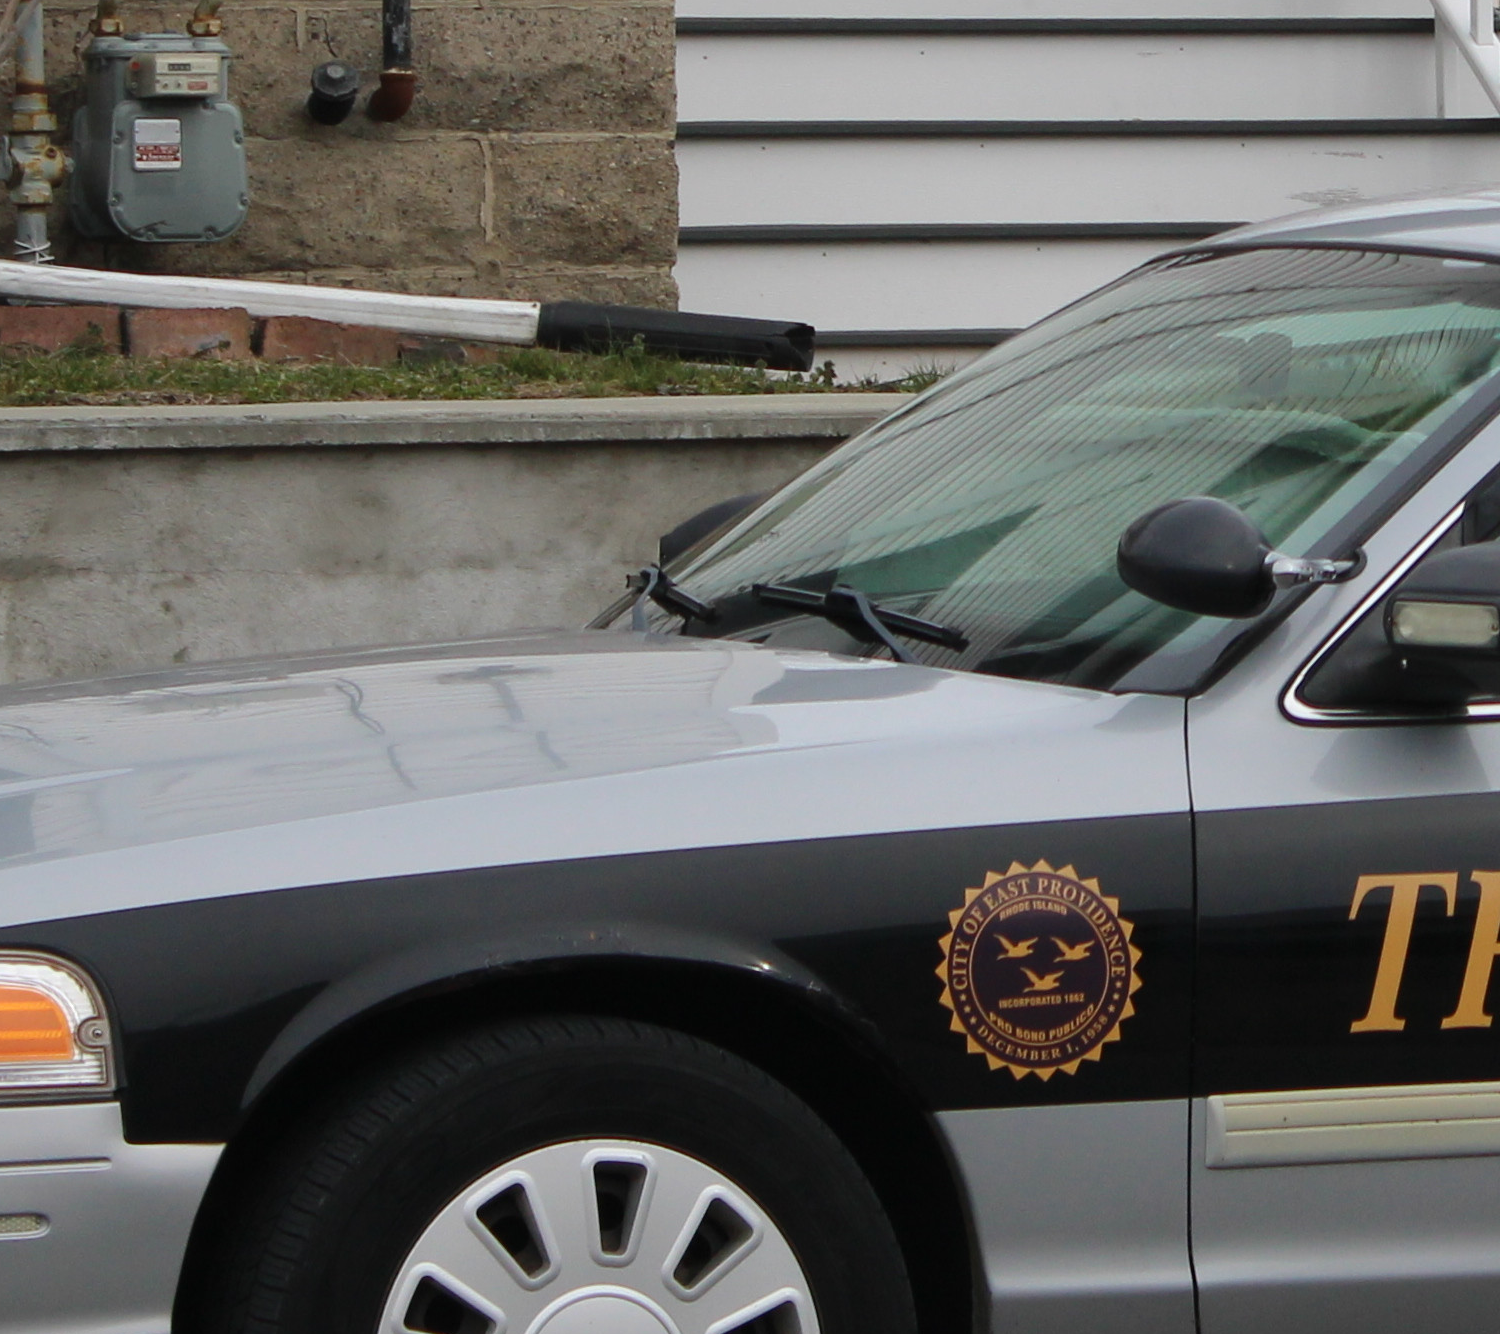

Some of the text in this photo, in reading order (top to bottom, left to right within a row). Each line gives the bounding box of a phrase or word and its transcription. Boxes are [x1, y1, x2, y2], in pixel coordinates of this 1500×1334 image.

[999, 900, 1068, 922] RHODE ISLAND
[952, 877, 1126, 990] CITY OF EAST PROVIDENCE
[998, 994, 1062, 1010] INCORPORATED
[977, 1024, 1062, 1061] DECEMBER
[1080, 1014, 1108, 1045] 1958
[988, 1003, 1095, 1042] PRO BONO PUBLICO
